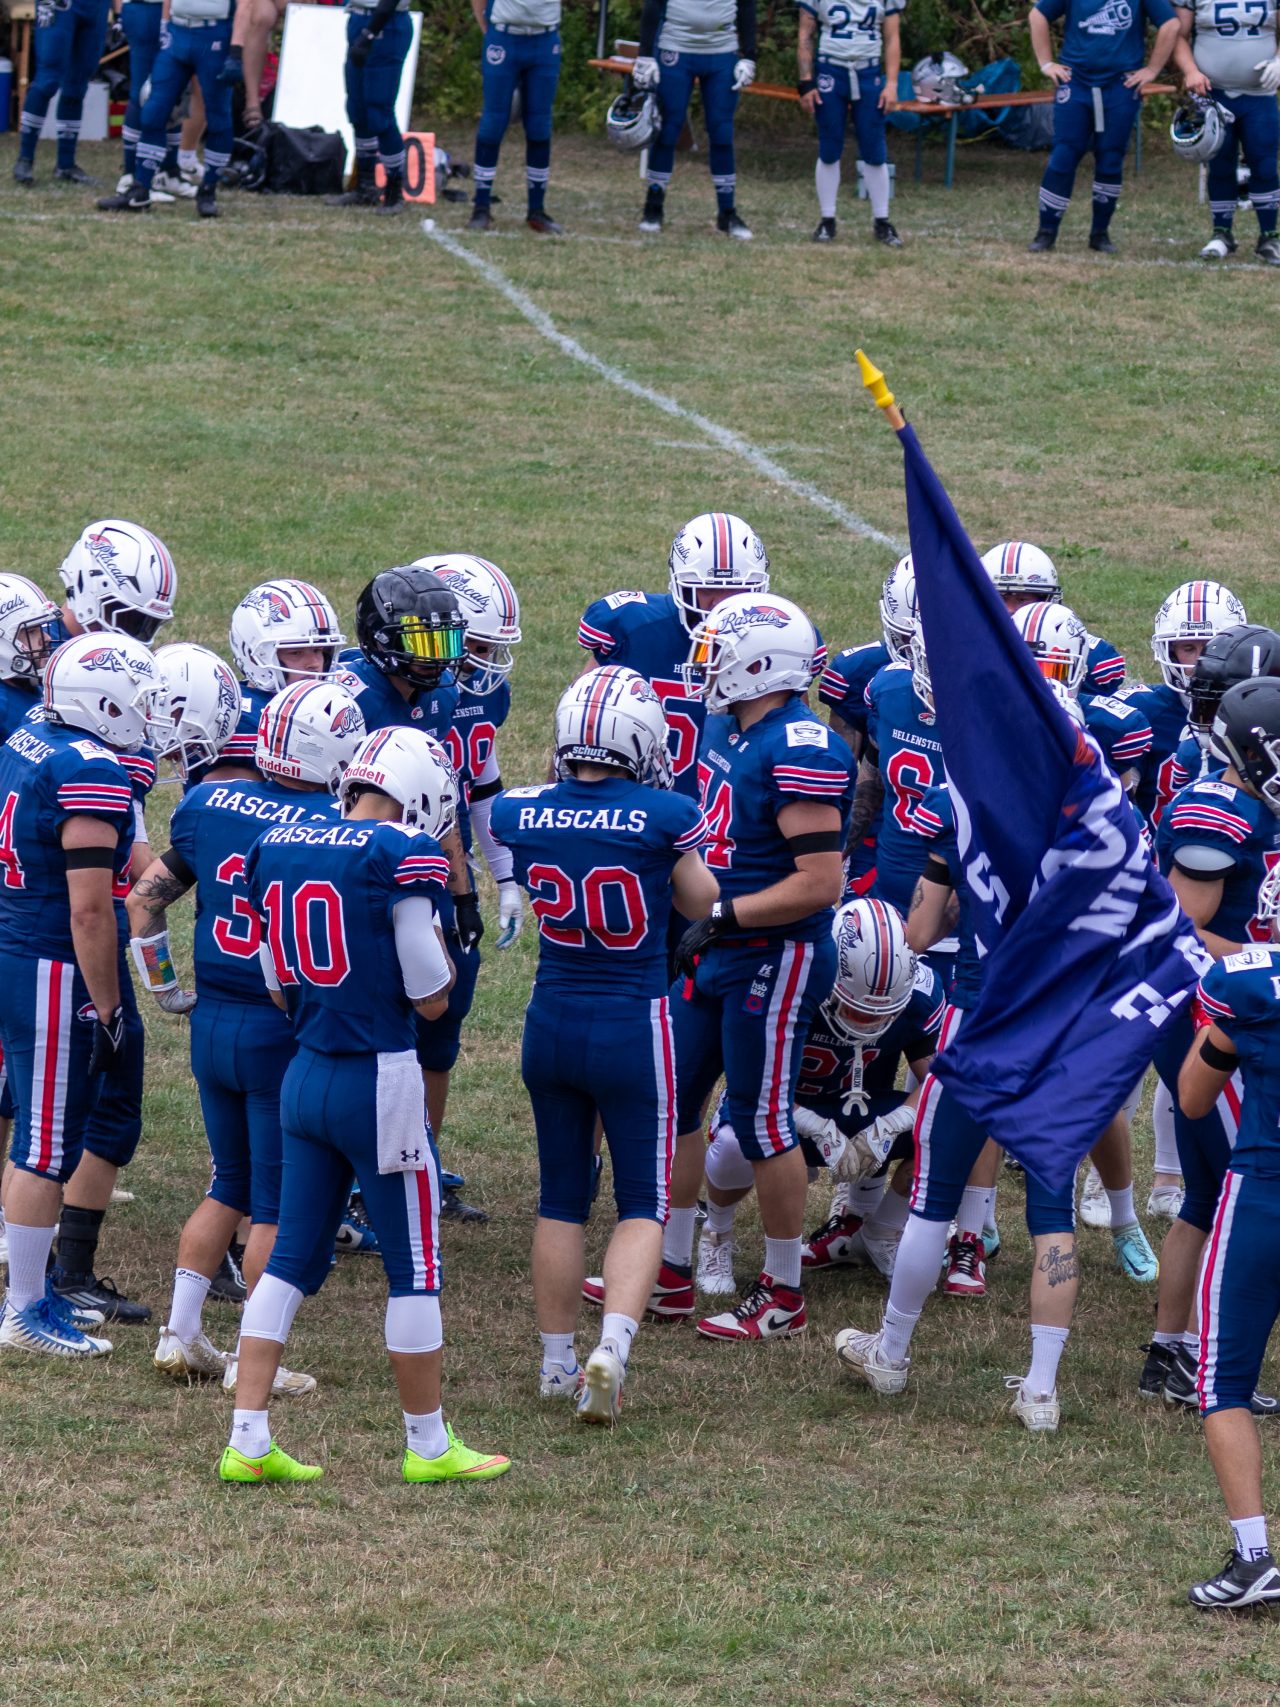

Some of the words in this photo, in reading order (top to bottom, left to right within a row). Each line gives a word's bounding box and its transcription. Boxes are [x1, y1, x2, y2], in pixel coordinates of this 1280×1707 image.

[828, 5, 877, 41] 24
[1214, 2, 1270, 37] 57
[404, 137, 425, 197] 0
[717, 610, 779, 636] Rascals
[5, 728, 56, 764] RASCALS
[572, 745, 608, 758] schutt
[258, 756, 301, 778] Riddell
[343, 768, 386, 786] Riddell
[519, 807, 648, 833] RASCALS
[262, 825, 374, 848] RASCALS
[527, 862, 650, 950] 20
[262, 880, 351, 988] 10
[750, 988, 765, 998] 1846
[752, 980, 768, 992] hsb
